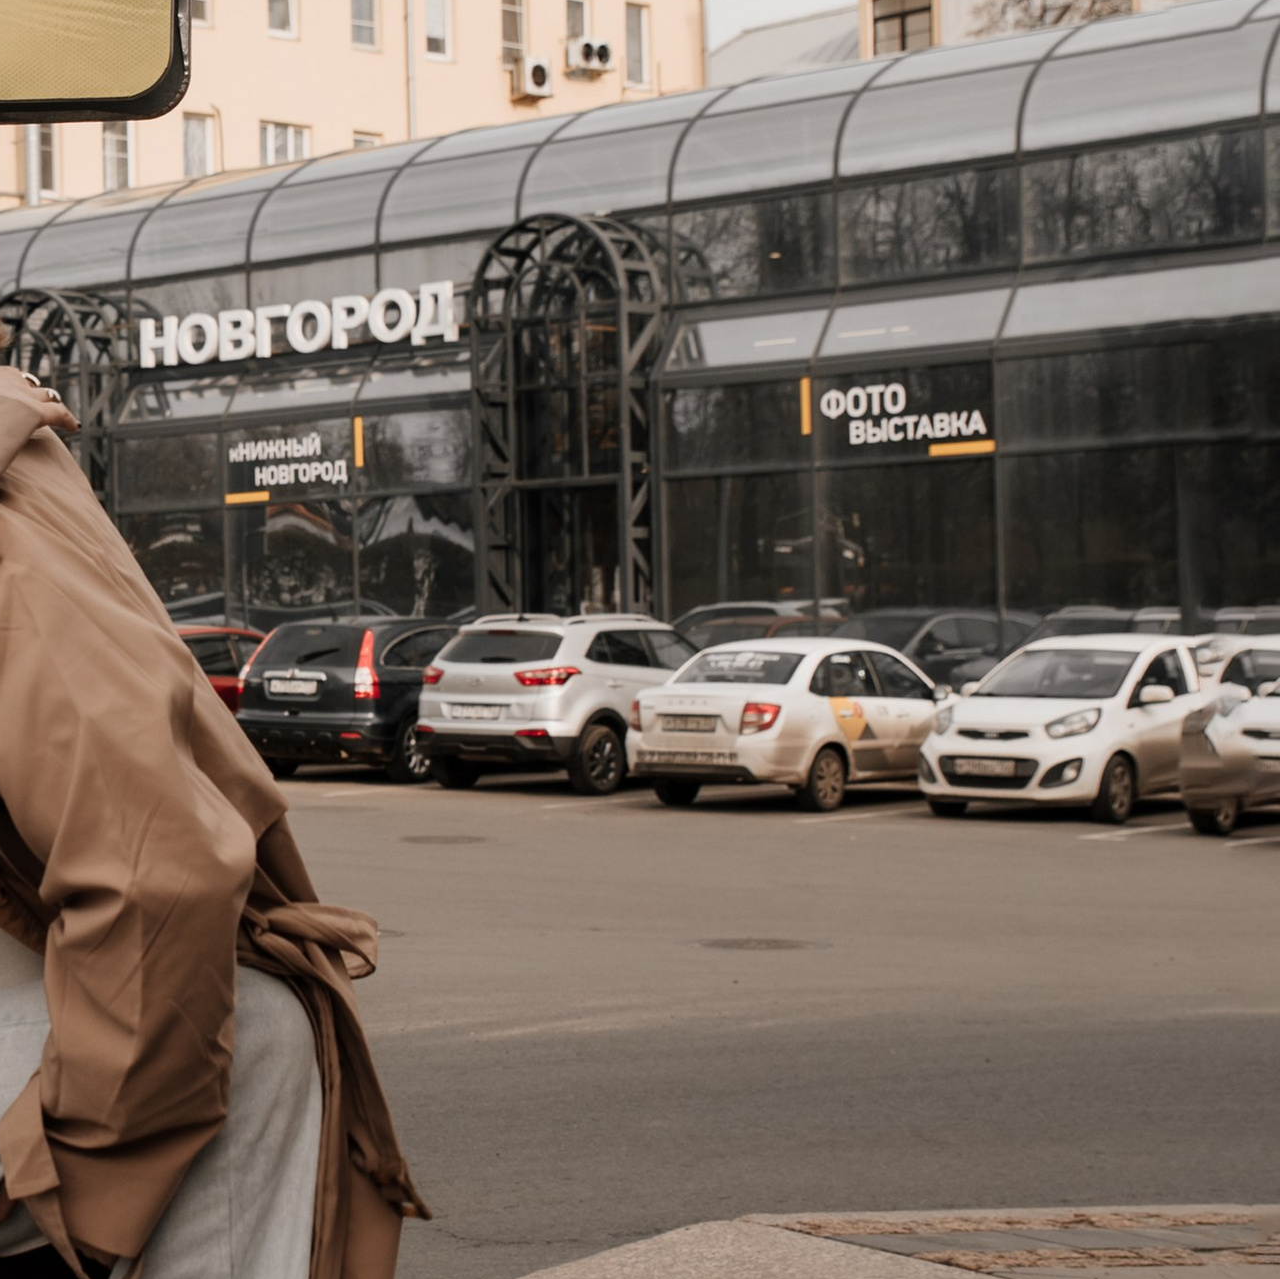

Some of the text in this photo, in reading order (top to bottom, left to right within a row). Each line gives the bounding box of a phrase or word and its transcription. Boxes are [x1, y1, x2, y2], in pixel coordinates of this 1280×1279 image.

[139, 280, 459, 369] НОВГОРОД
[820, 383, 907, 420] ФОТО
[849, 409, 987, 445] ВЫСТАВКА
[254, 459, 348, 487] НОВГОРОД
